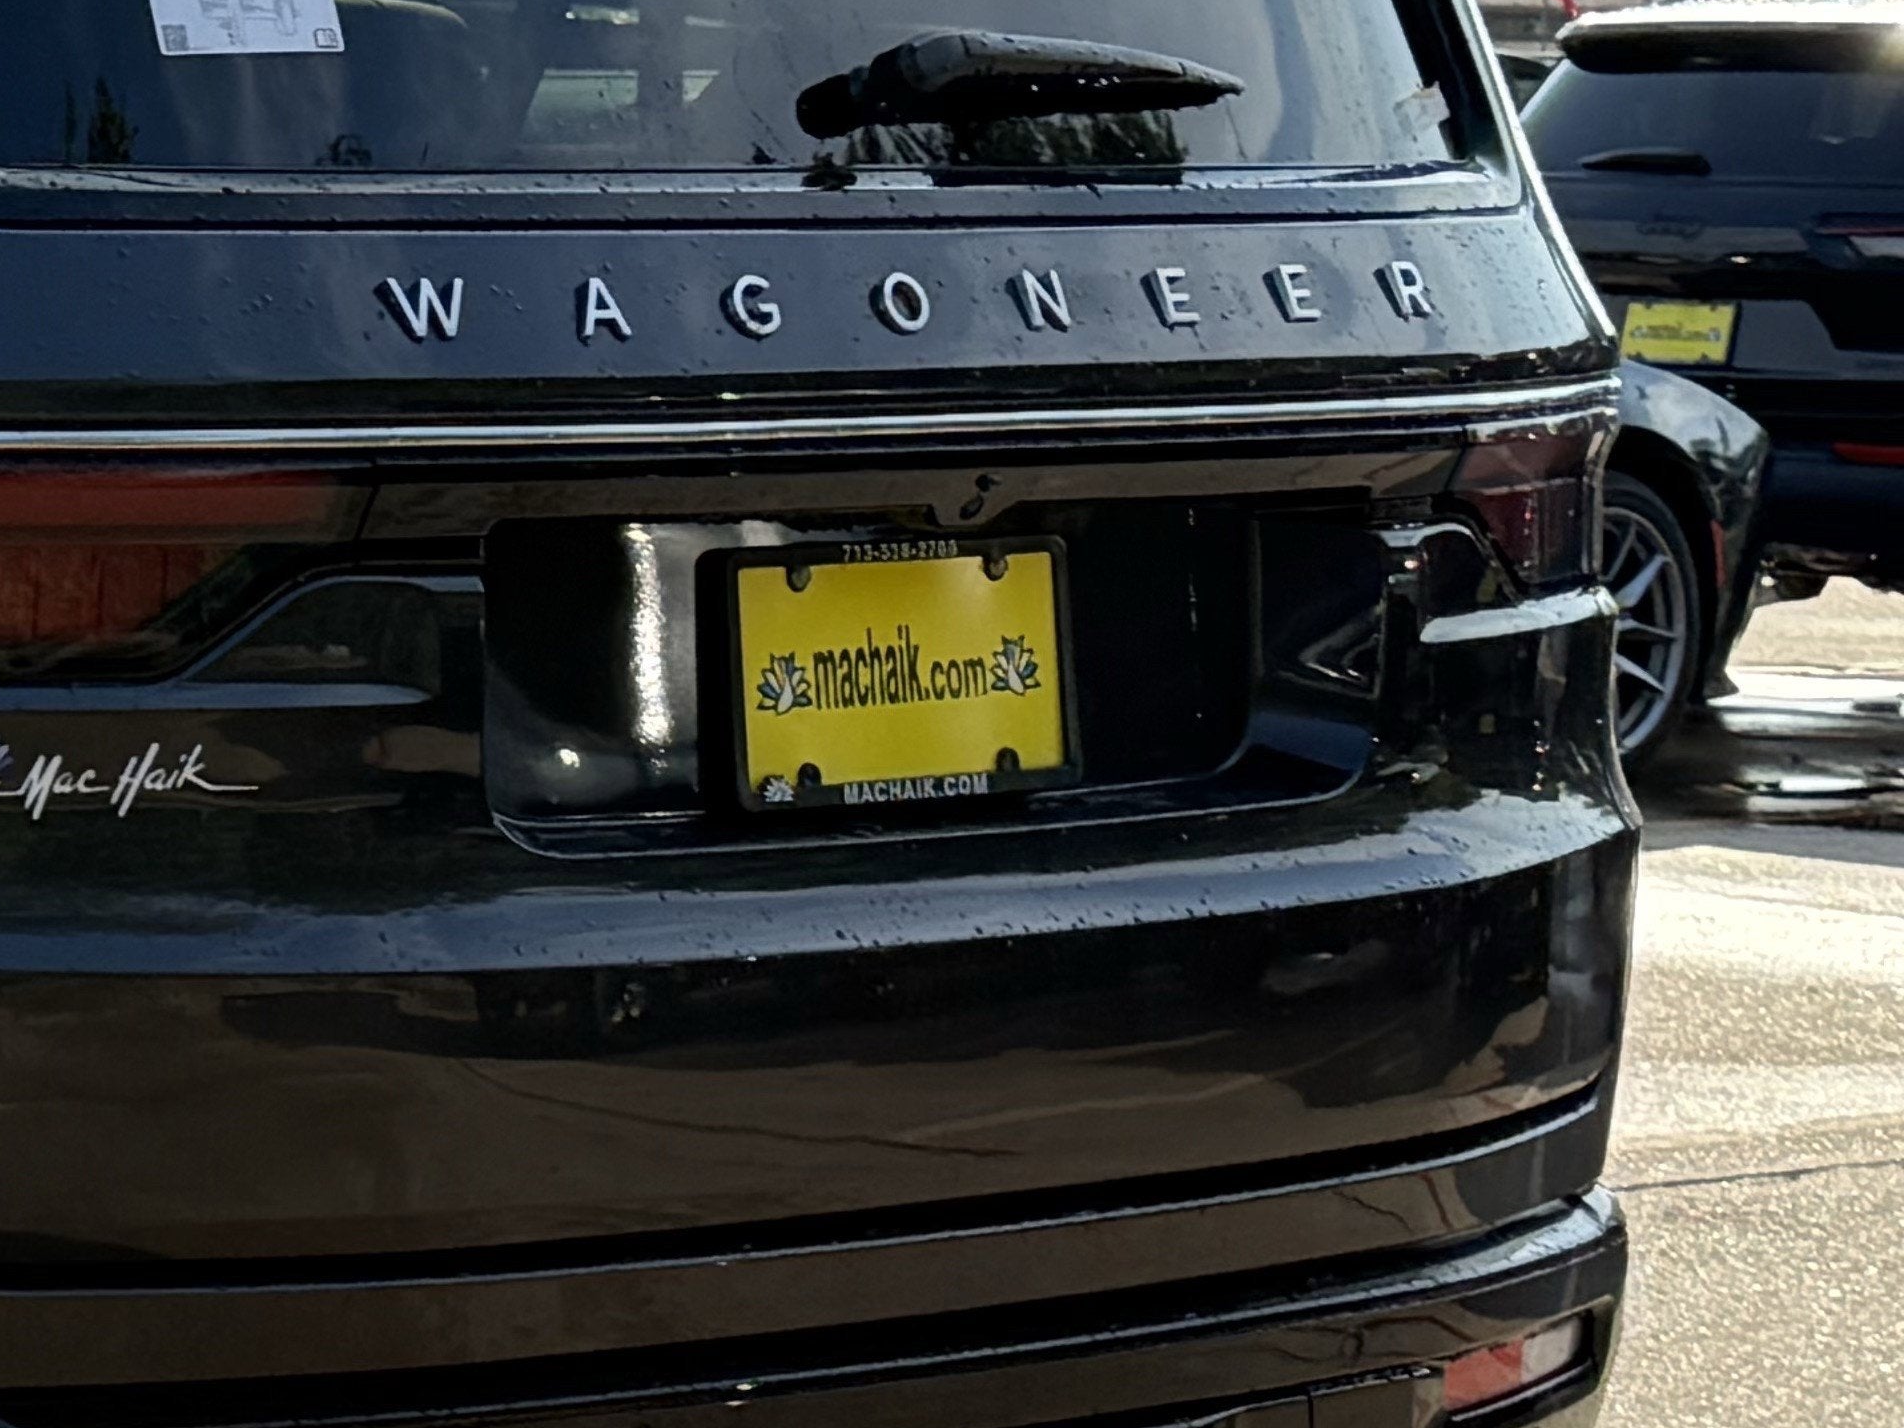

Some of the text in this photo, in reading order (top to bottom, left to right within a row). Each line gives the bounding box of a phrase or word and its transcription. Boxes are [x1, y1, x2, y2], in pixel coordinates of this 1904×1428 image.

[375, 259, 1434, 345] WAGONEER
[812, 624, 990, 711] machaik.com
[15, 742, 214, 821] Mac Haik
[843, 772, 990, 805] MACHAIK.COM
